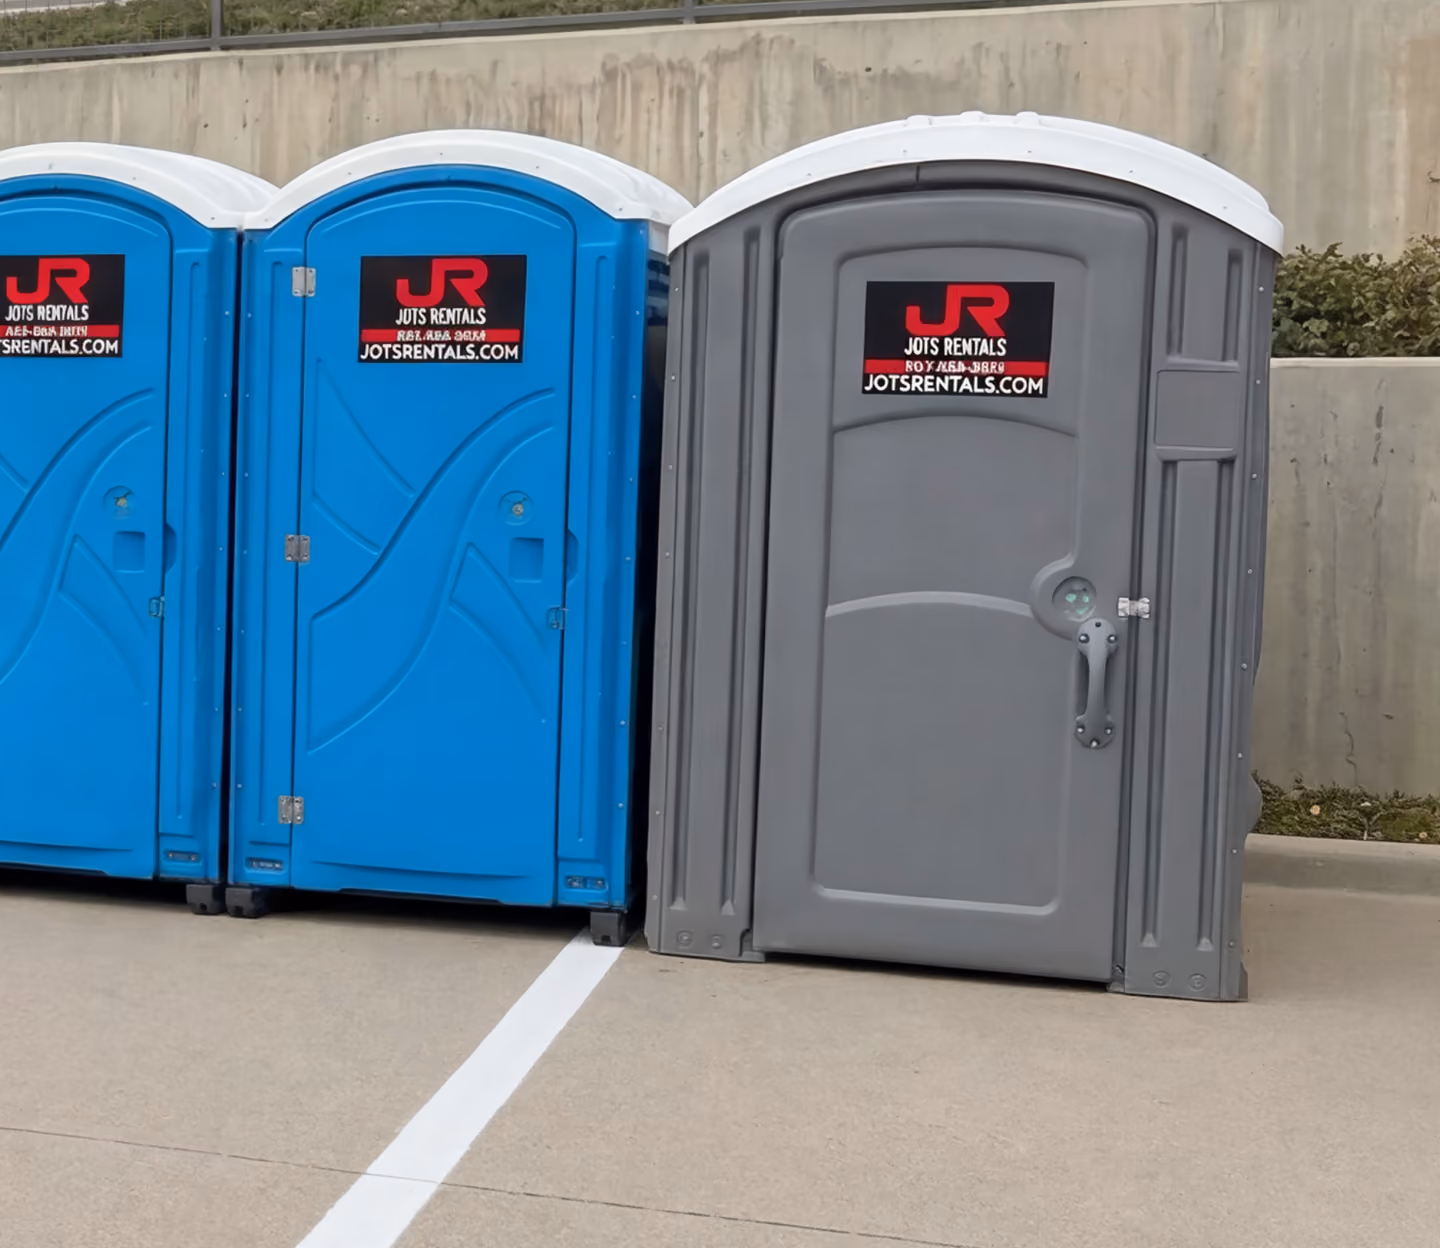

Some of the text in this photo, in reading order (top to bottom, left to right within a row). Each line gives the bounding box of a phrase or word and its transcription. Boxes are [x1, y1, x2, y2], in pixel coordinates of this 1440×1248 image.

[6, 258, 90, 304] JR
[396, 258, 488, 307] JR
[5, 305, 34, 321] JOTS
[430, 308, 486, 325] RENTALS
[905, 284, 1010, 336] JR
[360, 344, 519, 360] JOTSRENTALS.COM
[904, 337, 1007, 356] JOTS RENTALS
[864, 374, 1044, 394] JOTSRENTALS.COM
